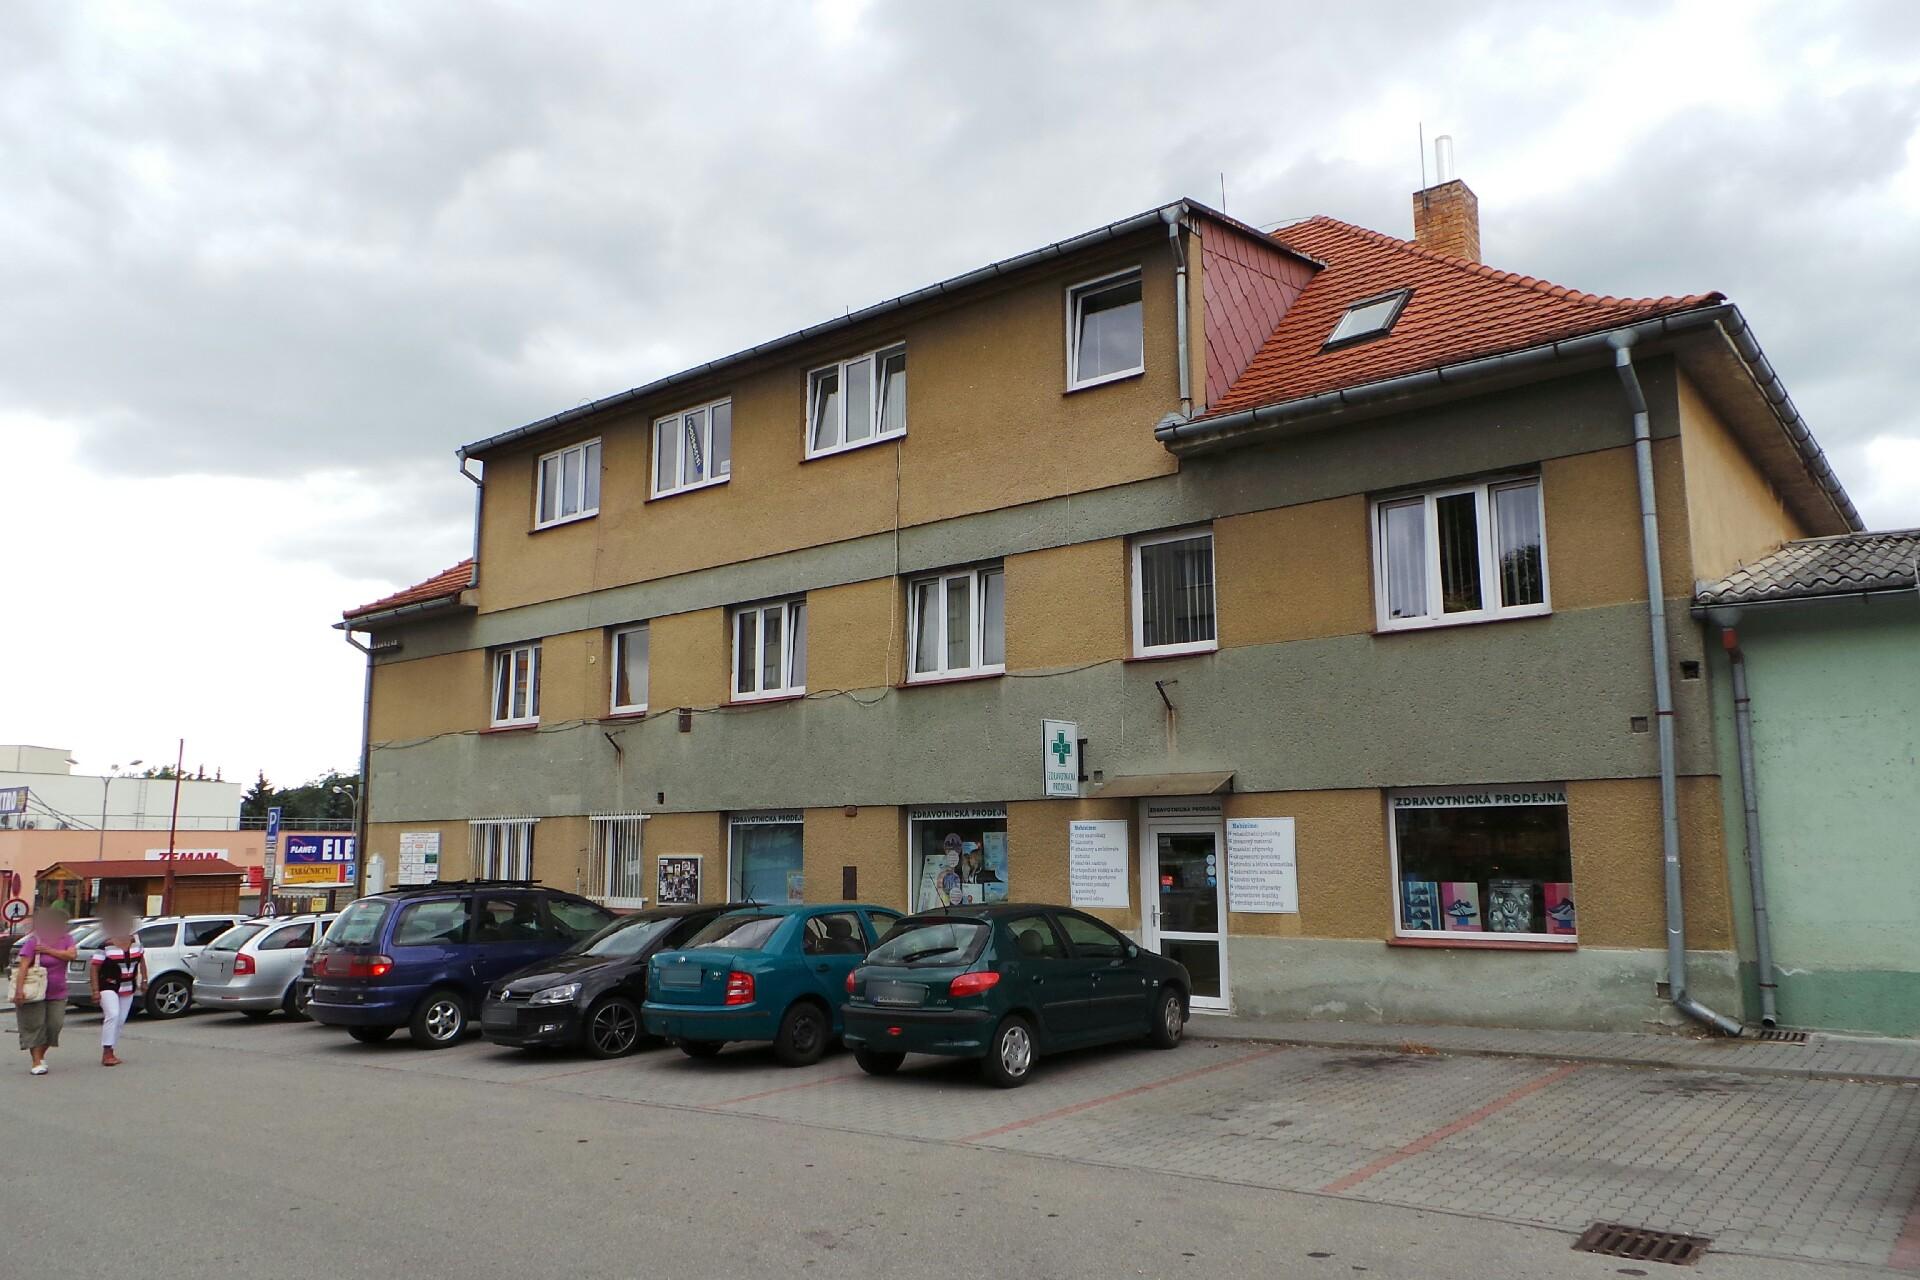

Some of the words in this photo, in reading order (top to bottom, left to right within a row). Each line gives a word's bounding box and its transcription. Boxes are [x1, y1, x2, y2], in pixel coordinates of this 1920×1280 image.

[1394, 792, 1491, 807] ZDRAVOTNICKÁ
[1495, 792, 1566, 804] PRODEJNA
[269, 811, 277, 832] P
[289, 845, 317, 854] PLANEO
